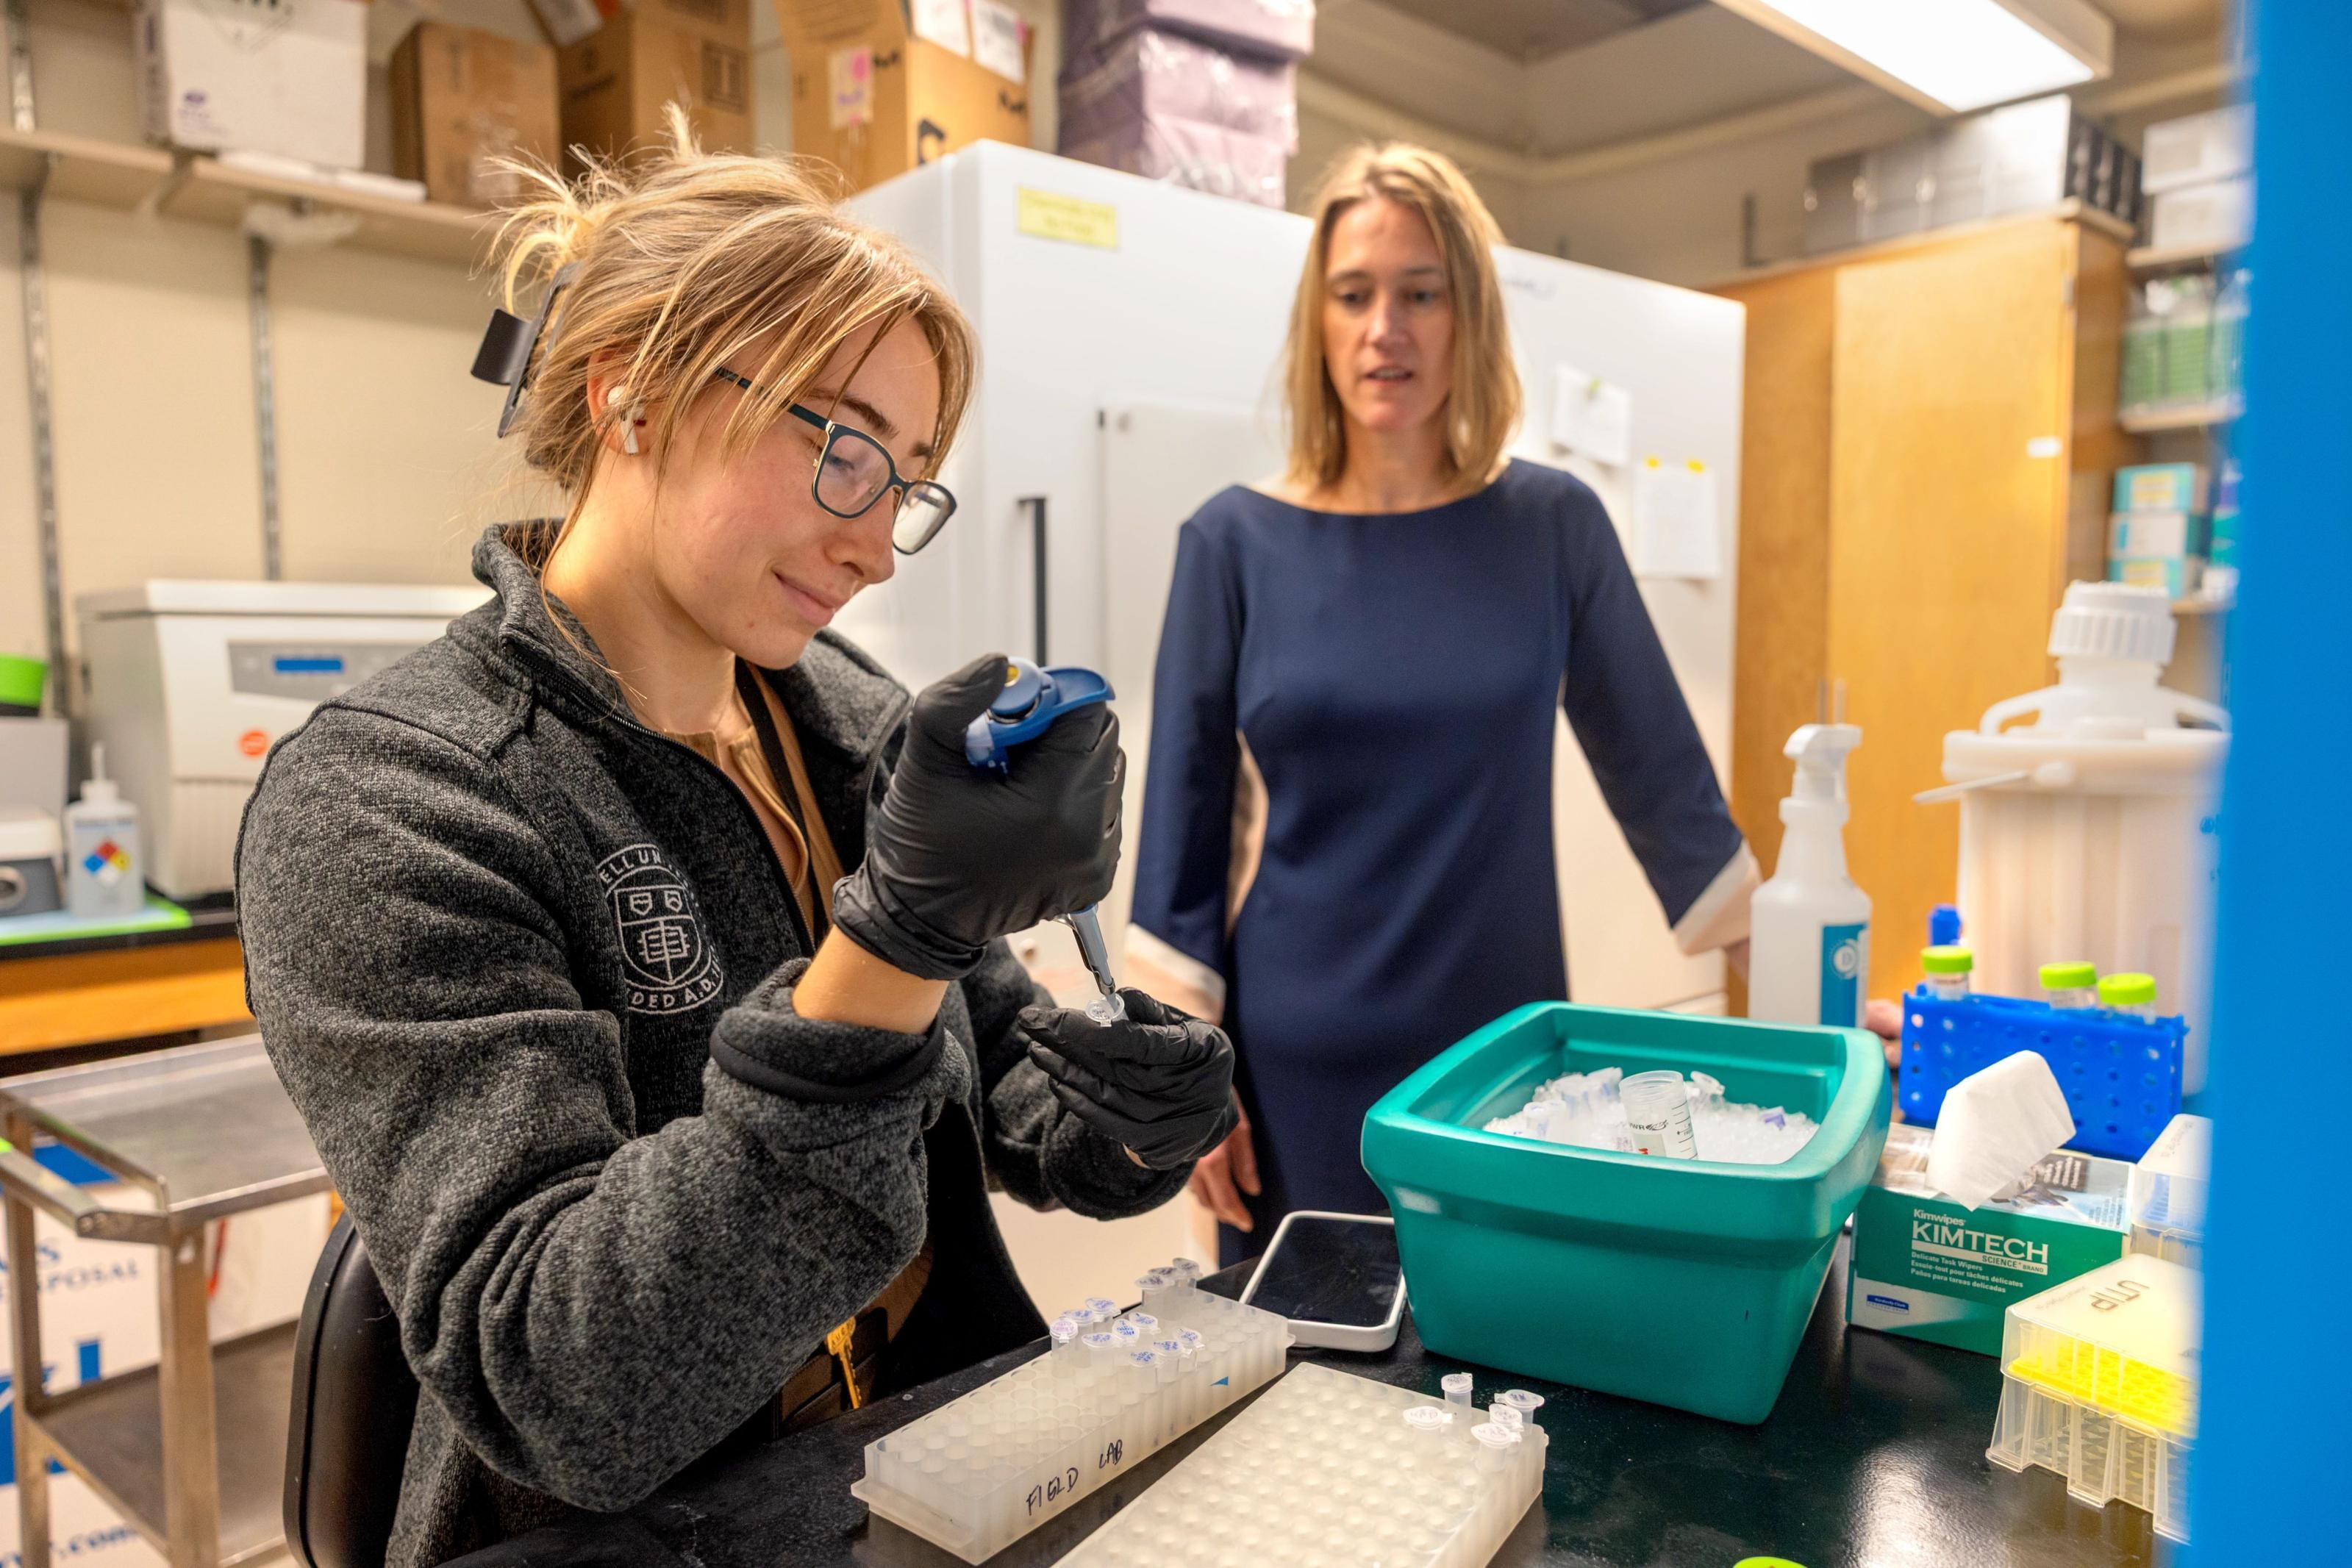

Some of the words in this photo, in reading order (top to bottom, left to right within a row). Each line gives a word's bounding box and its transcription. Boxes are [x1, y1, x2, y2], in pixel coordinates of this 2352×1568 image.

[631, 991, 676, 1008] DED
[1913, 1209, 1966, 1226] Kimwipes
[1912, 1220, 2049, 1264] KIMTECH
[1911, 1260, 1948, 1272] Essuie-tout
[1949, 1269, 1966, 1277] pour
[1912, 1251, 1940, 1262] Delicate
[1941, 1256, 1956, 1266] Task
[1958, 1261, 1983, 1271] Wipers
[2022, 1264, 2044, 1273] BRAND
[46, 1259, 138, 1293] POSAL
[1932, 1273, 1948, 1281] para
[1949, 1276, 1971, 1286] tareas
[1971, 1281, 2006, 1293] delicadas
[1026, 1467, 1079, 1516] FIELD
[1098, 1439, 1123, 1469] LAB
